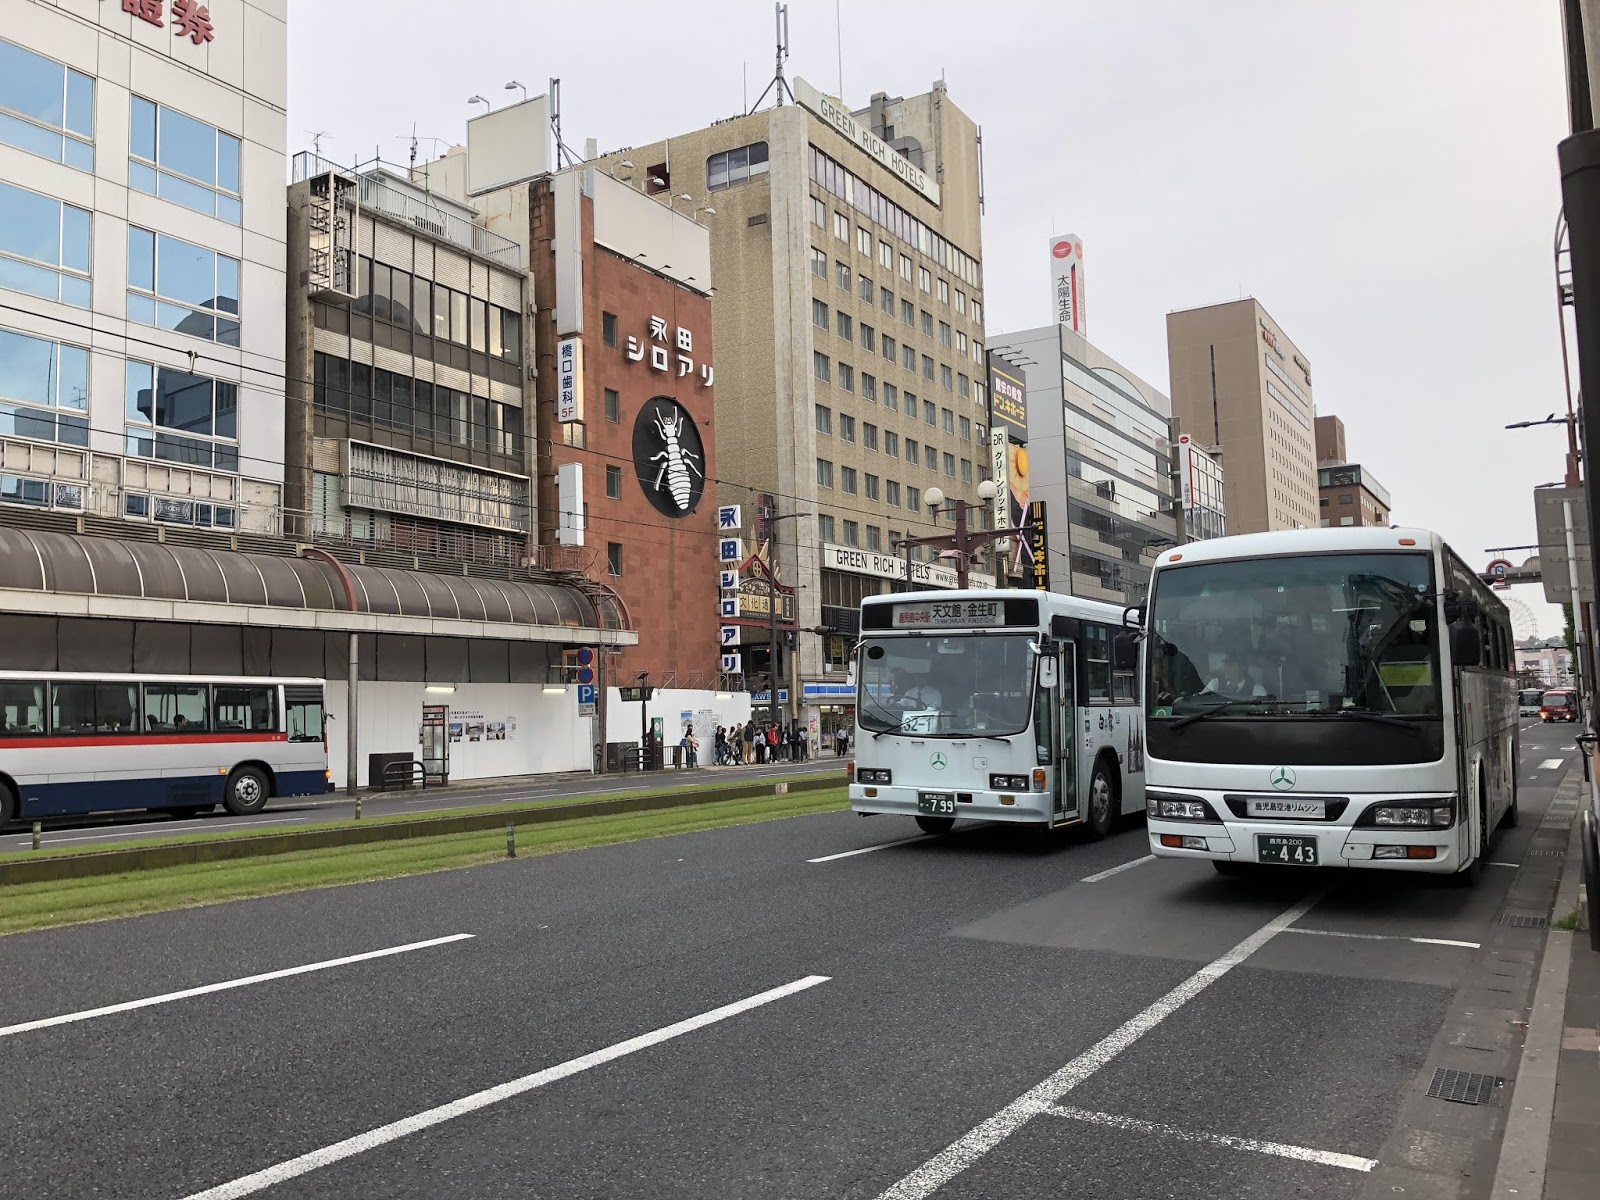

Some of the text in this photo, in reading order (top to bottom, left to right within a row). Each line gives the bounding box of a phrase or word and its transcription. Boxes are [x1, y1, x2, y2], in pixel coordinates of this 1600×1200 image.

[821, 99, 924, 190] GREEN RICH HOTELS
[1058, 275, 1071, 321] 太陽生命
[649, 314, 692, 352] 永田
[562, 344, 573, 404] 橋口歯科
[627, 335, 713, 387] シロアリ
[562, 407, 574, 418] 5F
[836, 550, 867, 569] GREEN
[873, 556, 894, 574] RICH
[900, 561, 929, 580] HTELS
[933, 603, 997, 618] 天文館・金生町
[752, 692, 782, 700] AWSN
[1255, 802, 1318, 812] 鹿児島空港リムジン
